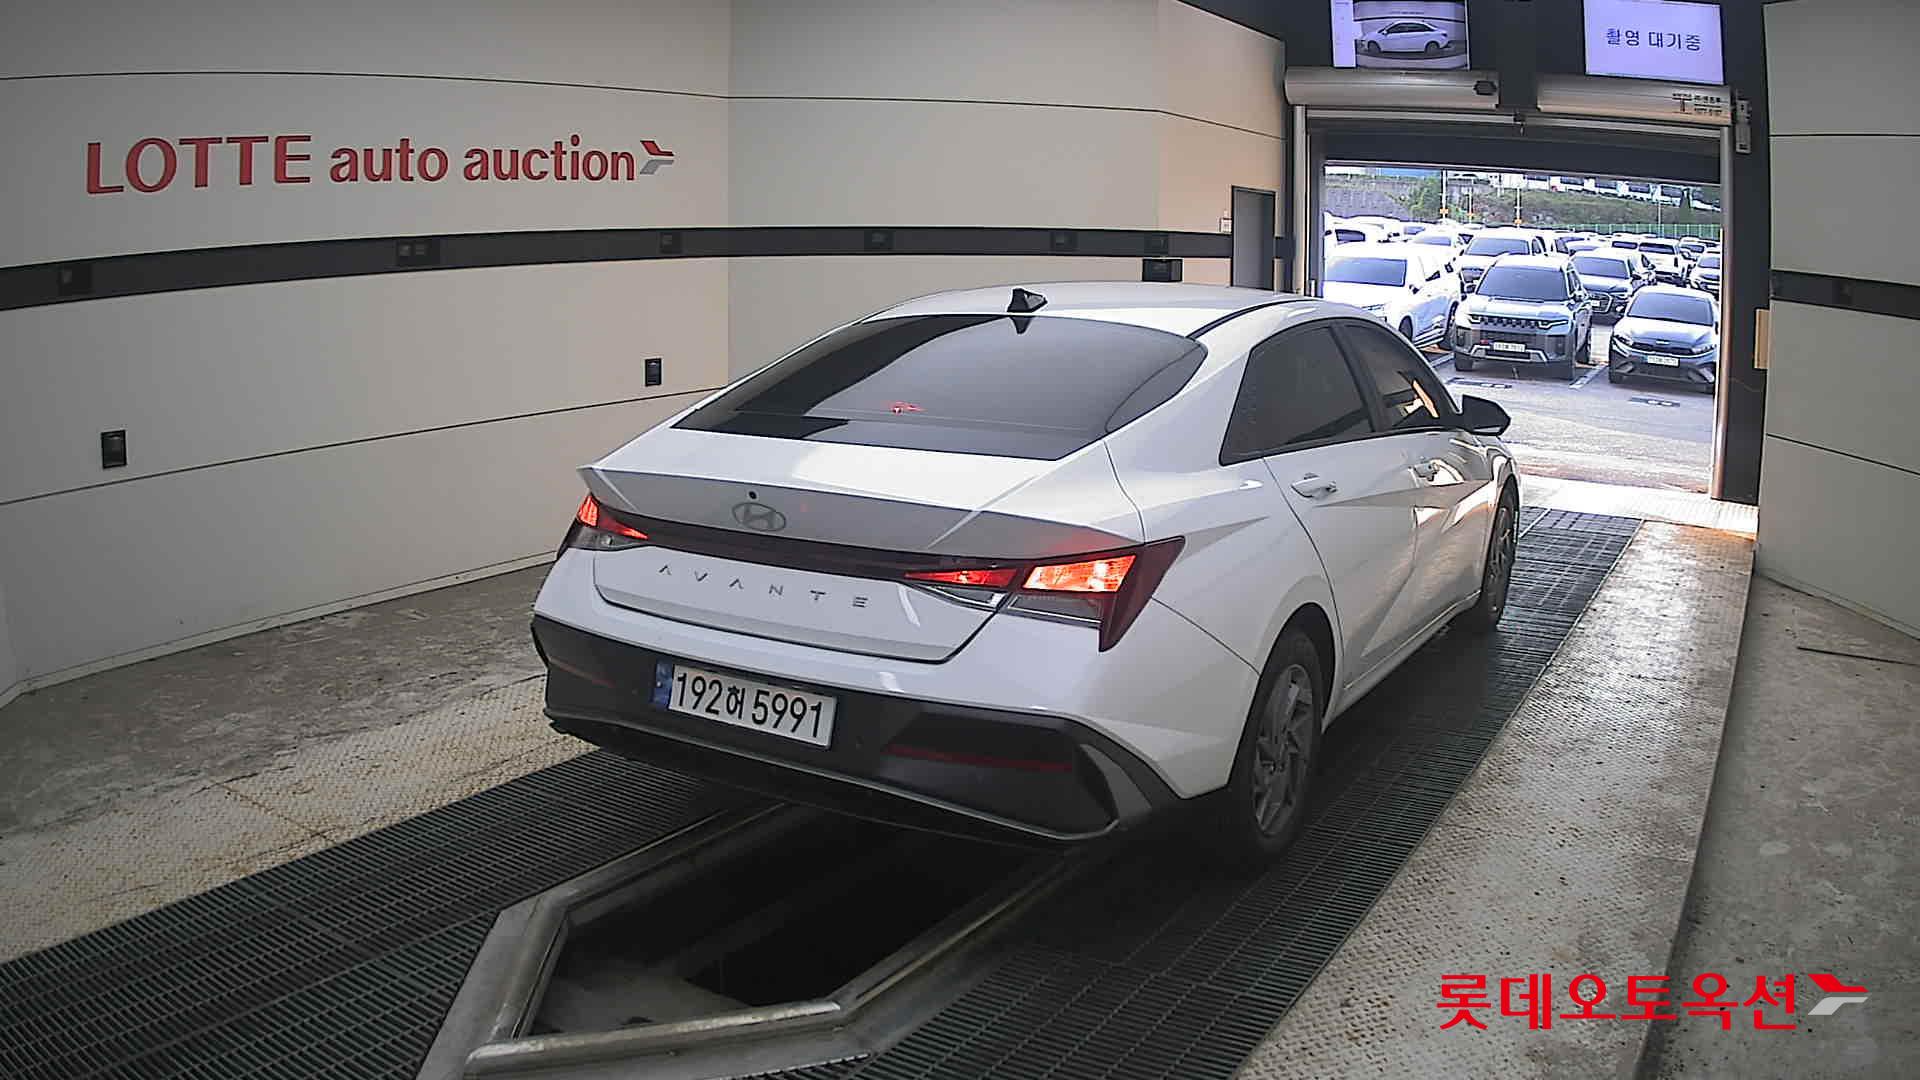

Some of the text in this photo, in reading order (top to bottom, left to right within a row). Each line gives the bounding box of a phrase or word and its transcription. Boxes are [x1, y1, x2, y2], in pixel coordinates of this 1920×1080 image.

[1648, 31, 1701, 52] 대기중
[86, 134, 635, 194] LOTTE auto auction
[658, 564, 869, 608] AVANTE
